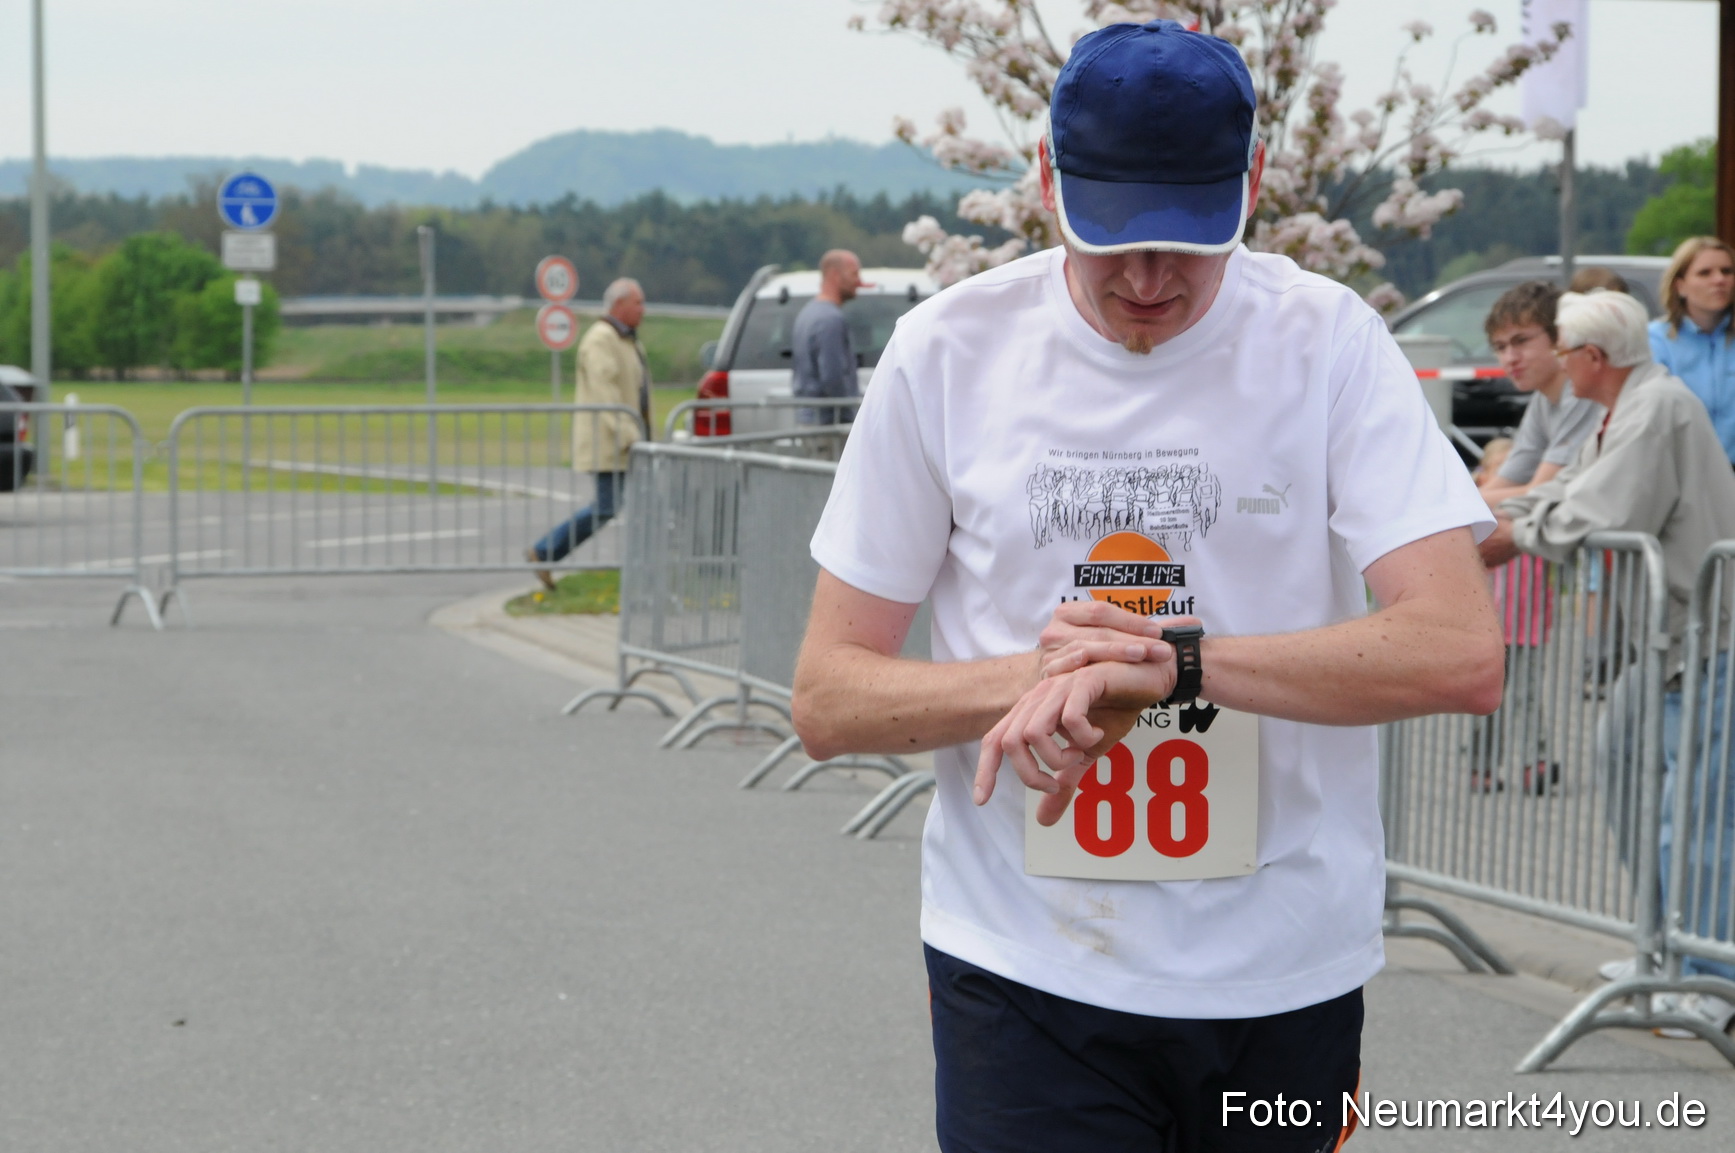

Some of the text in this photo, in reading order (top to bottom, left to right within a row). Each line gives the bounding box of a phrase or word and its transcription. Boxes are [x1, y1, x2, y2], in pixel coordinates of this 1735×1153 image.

[1048, 447, 1199, 460] Wir bringen Nürnberg in Bewegung
[1237, 497, 1280, 514] PUMA
[1079, 565, 1182, 585] FINISH LINE
[1061, 595, 1195, 616] bstlauf
[1073, 738, 1210, 859] 88
